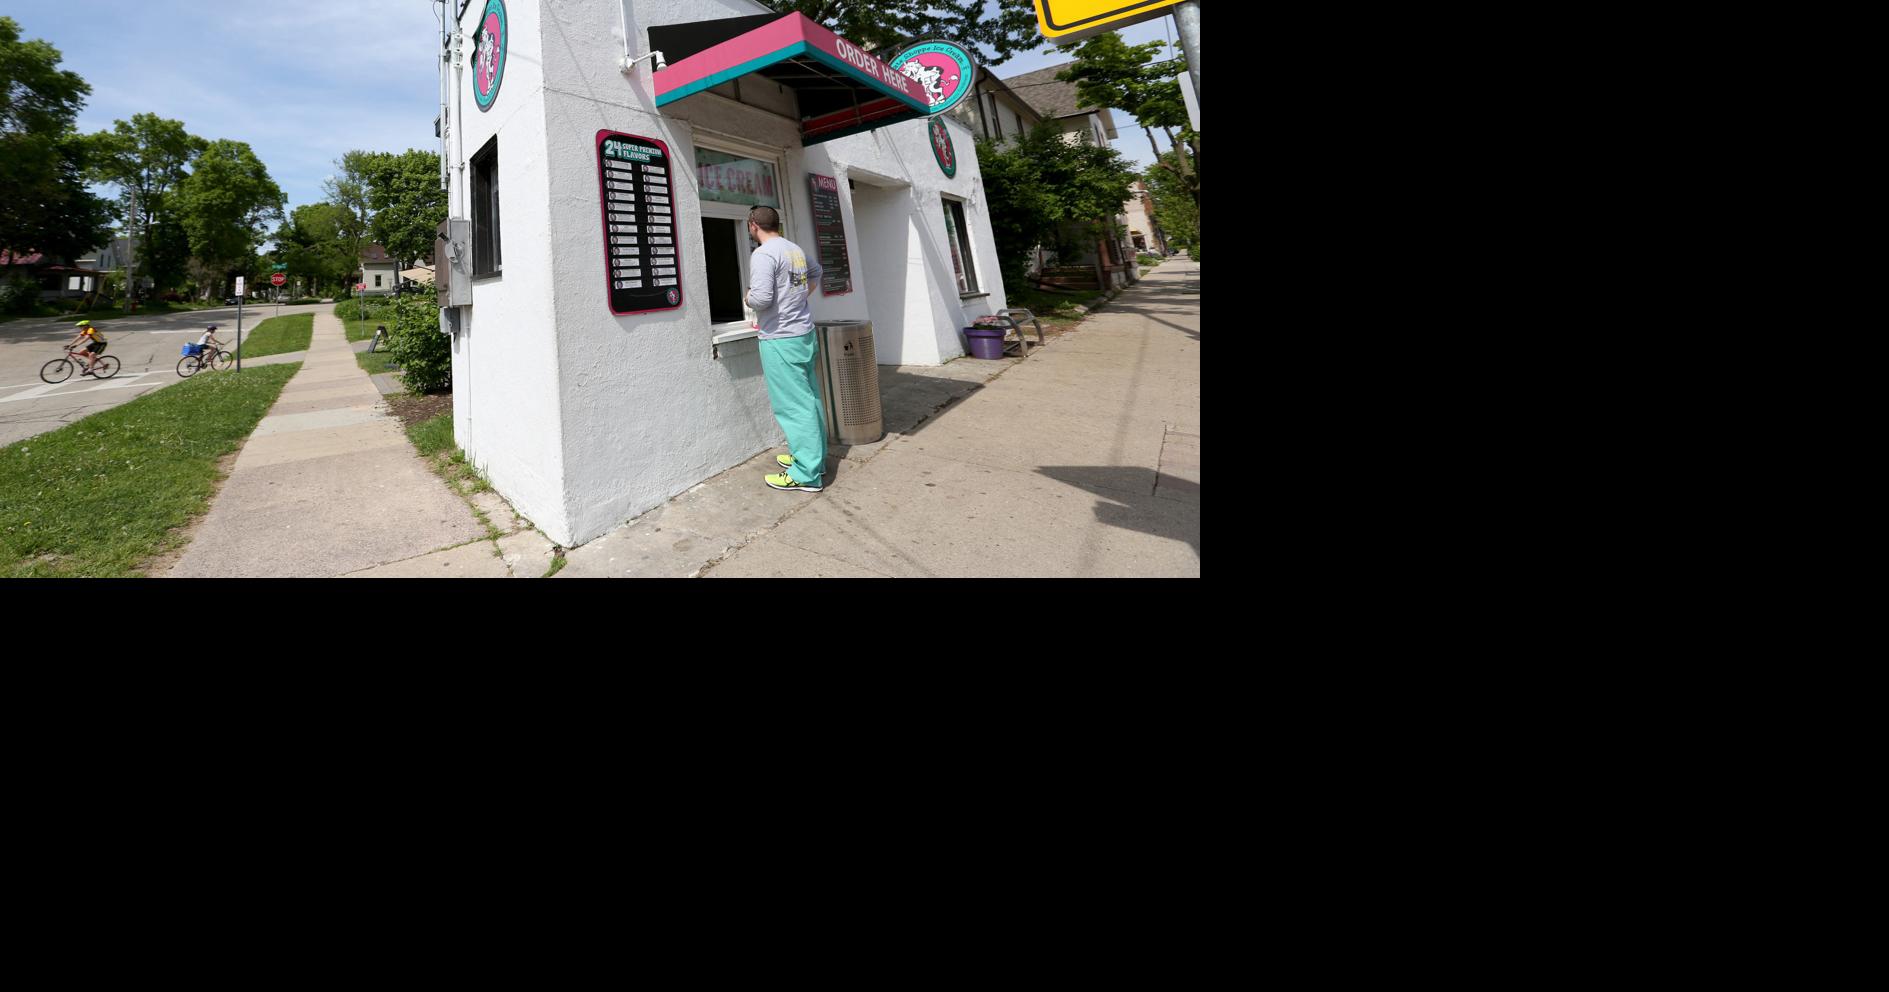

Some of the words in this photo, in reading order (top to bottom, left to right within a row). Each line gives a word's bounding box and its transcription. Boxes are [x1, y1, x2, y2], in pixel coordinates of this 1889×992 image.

[836, 38, 880, 78] ORDER
[881, 65, 910, 94] HERE
[605, 139, 622, 157] 24
[622, 143, 639, 152] SUPER
[623, 151, 650, 160] FLAVORS
[727, 167, 773, 197] CREAM
[818, 176, 837, 191] MENU
